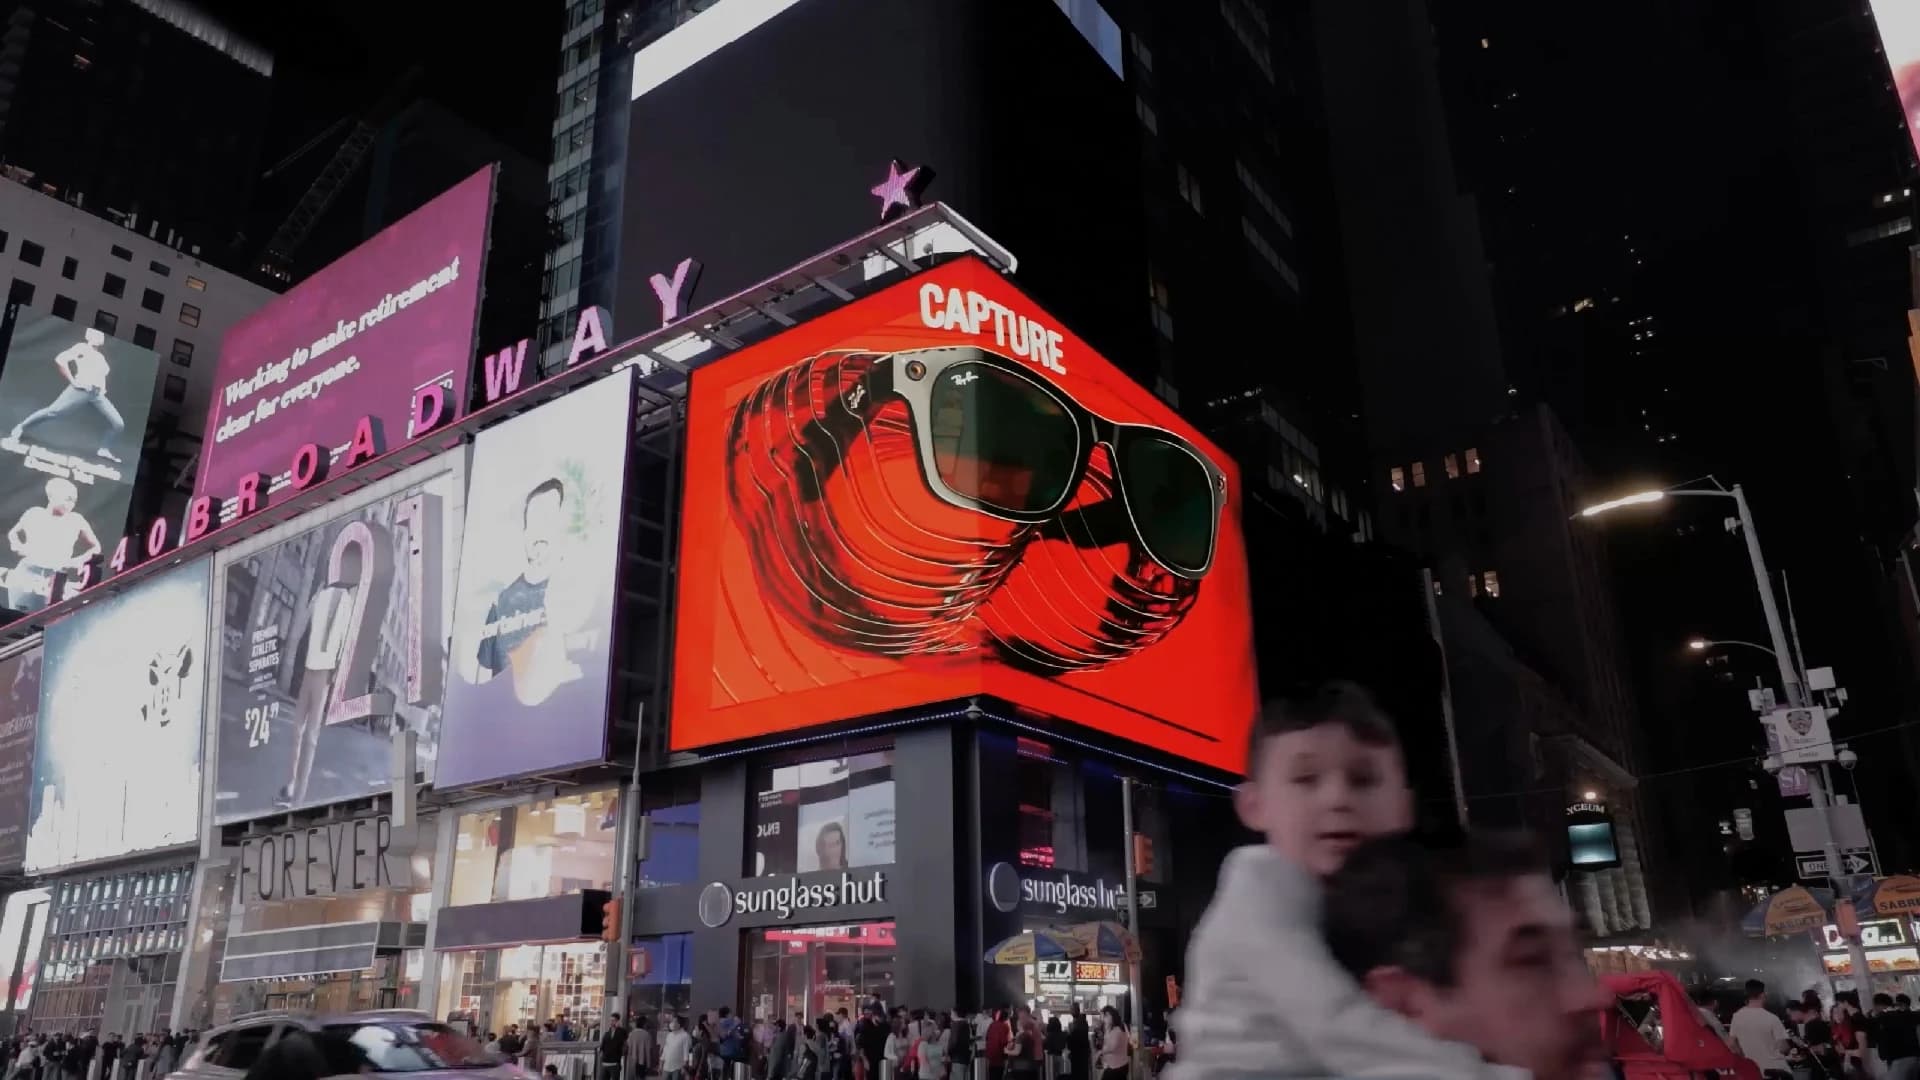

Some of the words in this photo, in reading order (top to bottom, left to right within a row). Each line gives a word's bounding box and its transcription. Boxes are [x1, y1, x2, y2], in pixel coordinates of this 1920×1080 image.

[226, 356, 291, 407] Working
[291, 347, 309, 370] to
[309, 320, 357, 359] make
[358, 255, 460, 333] retirement
[919, 282, 1066, 375] CAPTURE
[187, 257, 694, 541] BROADWAY
[216, 409, 255, 444] clear
[255, 395, 280, 423] for
[280, 355, 361, 409] everyone.
[251, 639, 278, 658] ATHLETIC
[325, 494, 443, 725] 21
[248, 652, 280, 673] SEPARATES
[239, 814, 392, 904] FOREVER
[735, 877, 835, 919] sunglass
[842, 871, 884, 905] hut
[1023, 873, 1097, 914] sunglass
